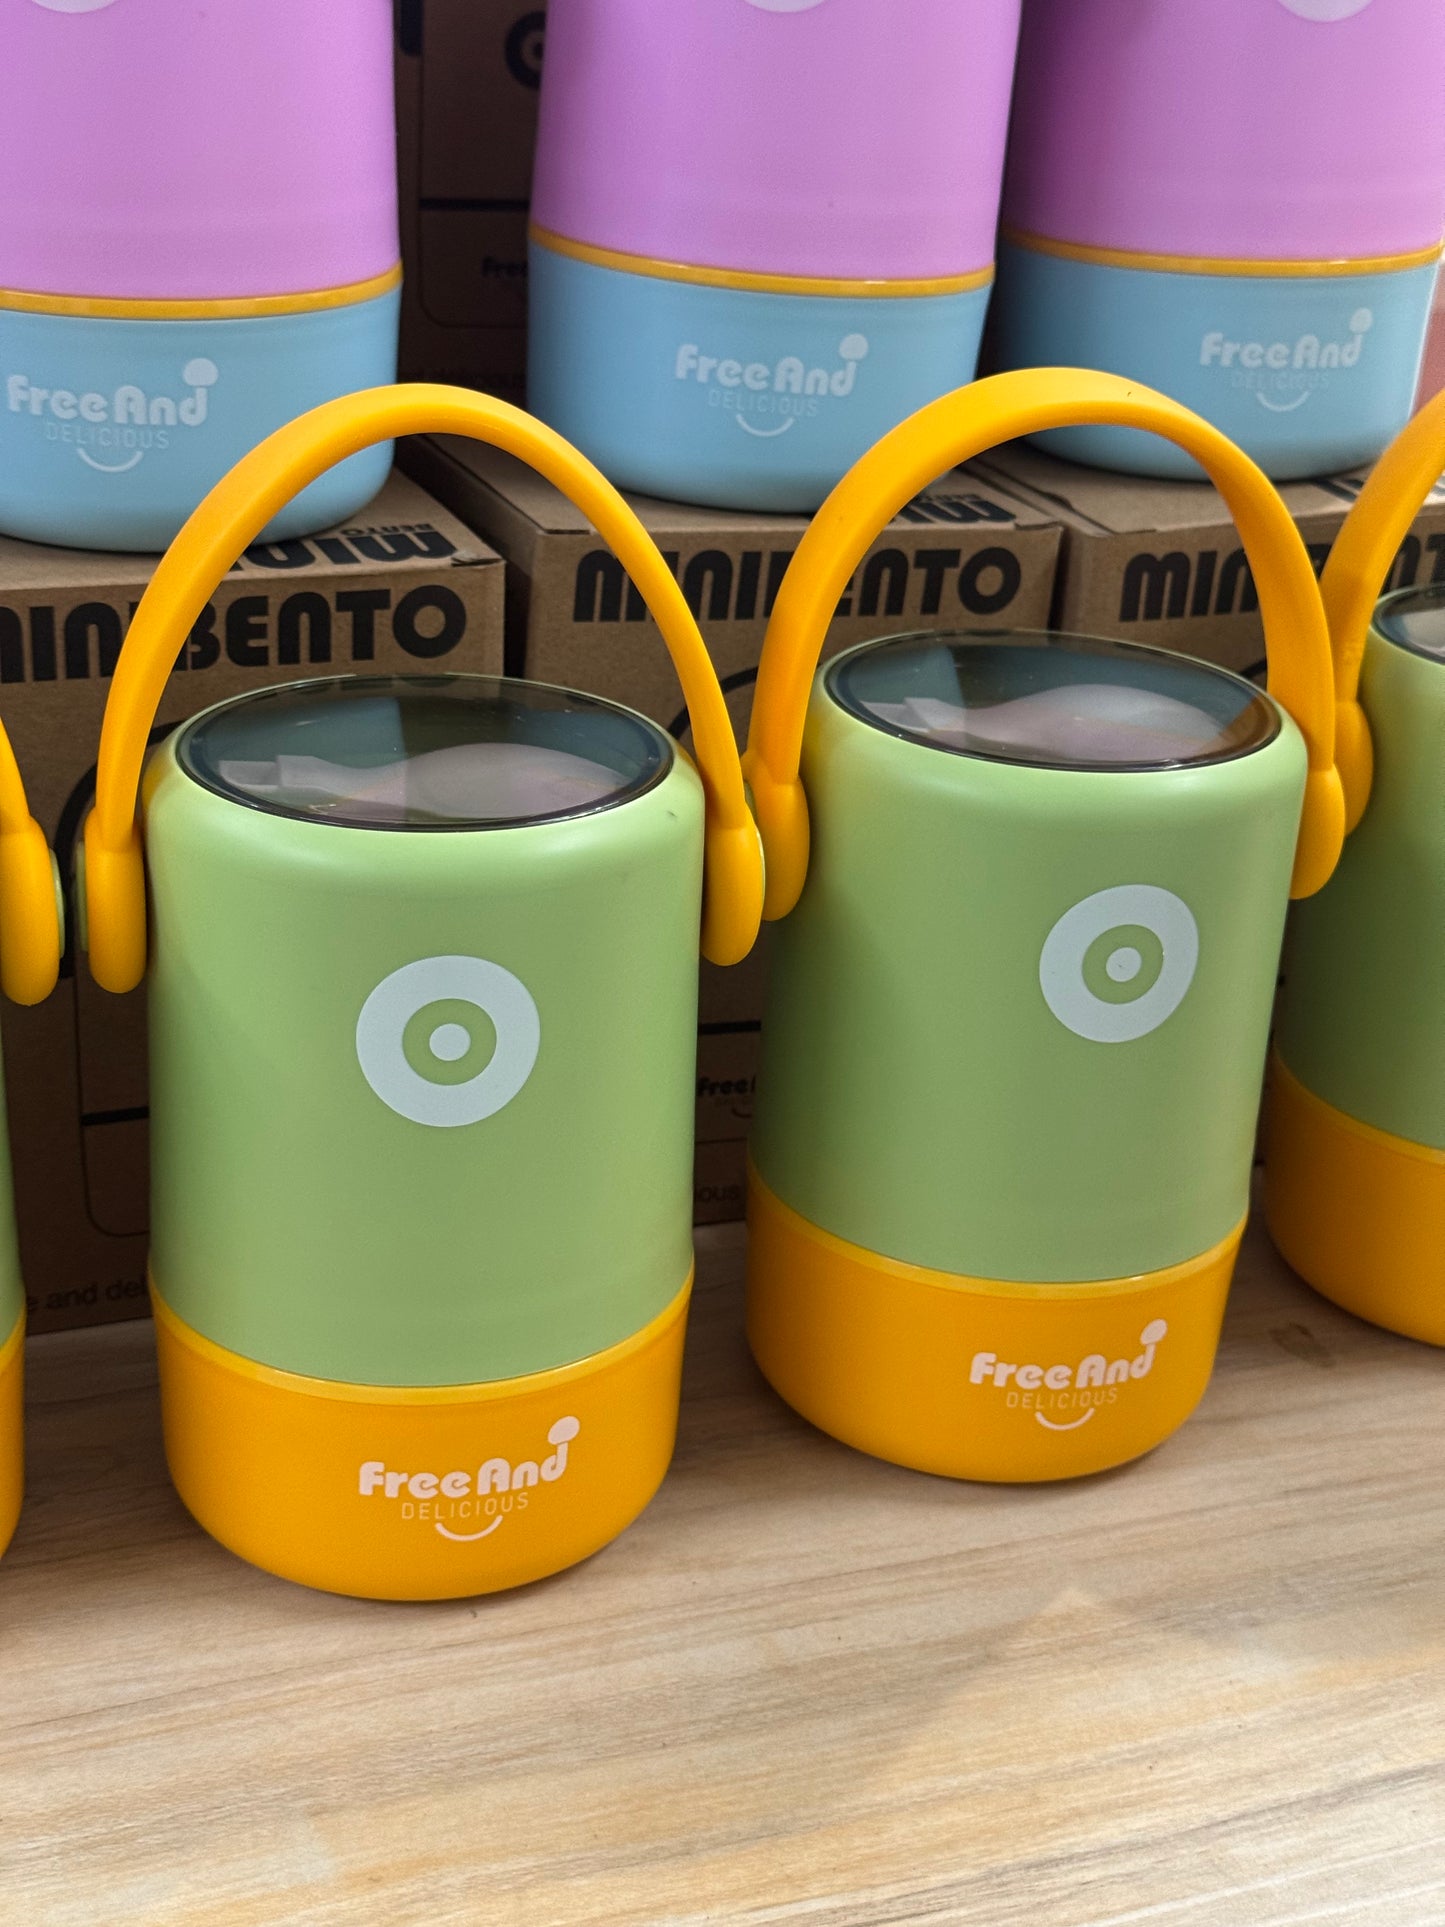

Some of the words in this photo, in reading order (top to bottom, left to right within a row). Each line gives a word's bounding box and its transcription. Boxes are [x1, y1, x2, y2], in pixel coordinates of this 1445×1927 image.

[708, 388, 819, 417] DELICIOUS
[46, 421, 171, 450] DELICIOUS
[46, 1281, 99, 1309] and
[1006, 1387, 1118, 1410] DELICIOUS
[402, 1492, 529, 1520] DELICIOUS
